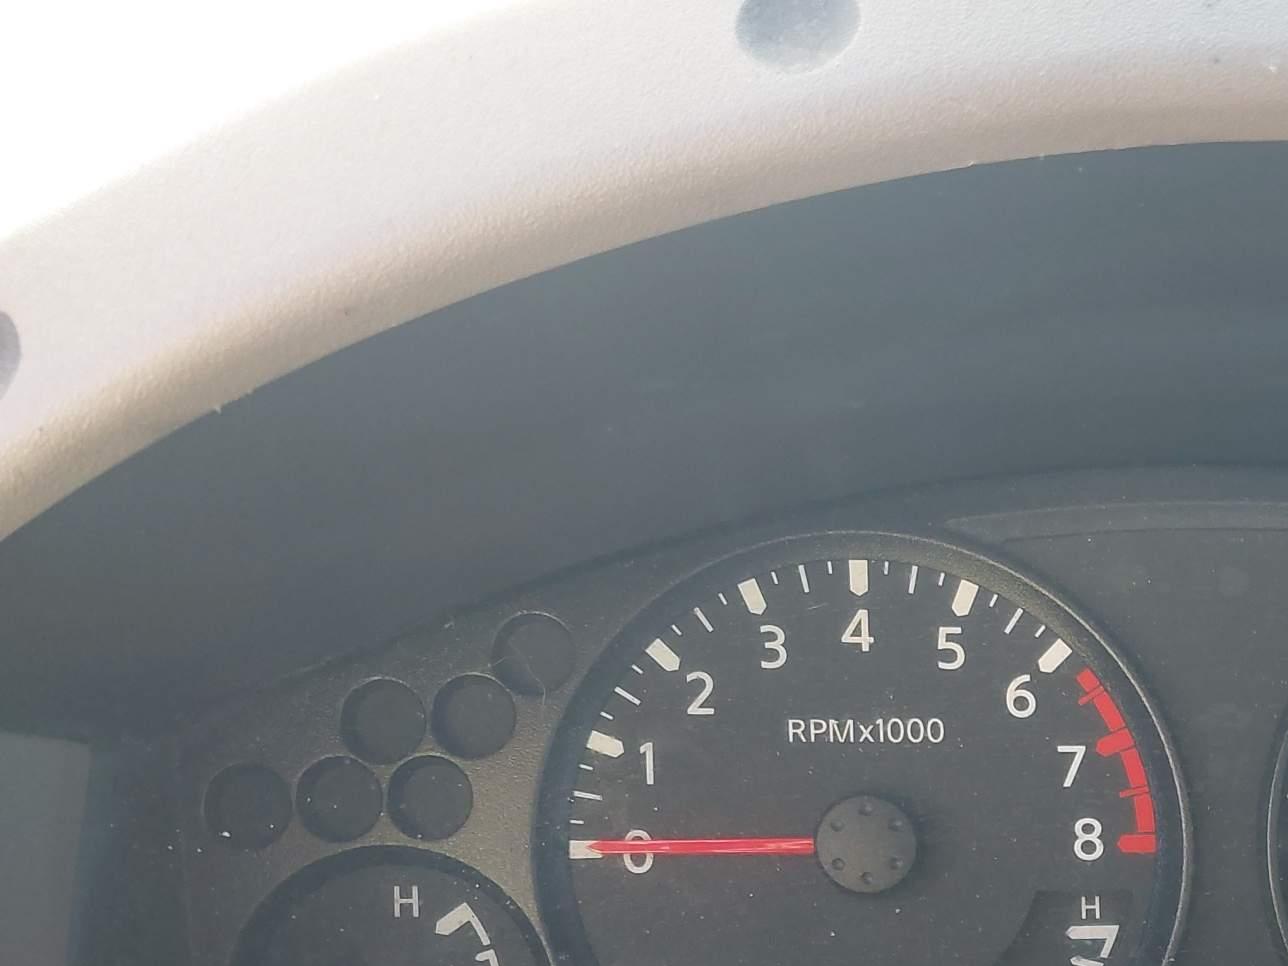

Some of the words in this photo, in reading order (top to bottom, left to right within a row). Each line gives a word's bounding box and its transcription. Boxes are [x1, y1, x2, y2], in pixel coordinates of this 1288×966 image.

[759, 624, 788, 669] 3
[841, 608, 874, 652] 4
[937, 626, 966, 670] 5
[686, 671, 715, 715] 2
[1005, 674, 1036, 718] 6
[788, 718, 945, 743] RPMx1000
[639, 742, 654, 785] 1
[1056, 745, 1086, 788] 7
[1073, 817, 1104, 861] 8
[393, 885, 420, 918] H
[1081, 895, 1101, 919] H
